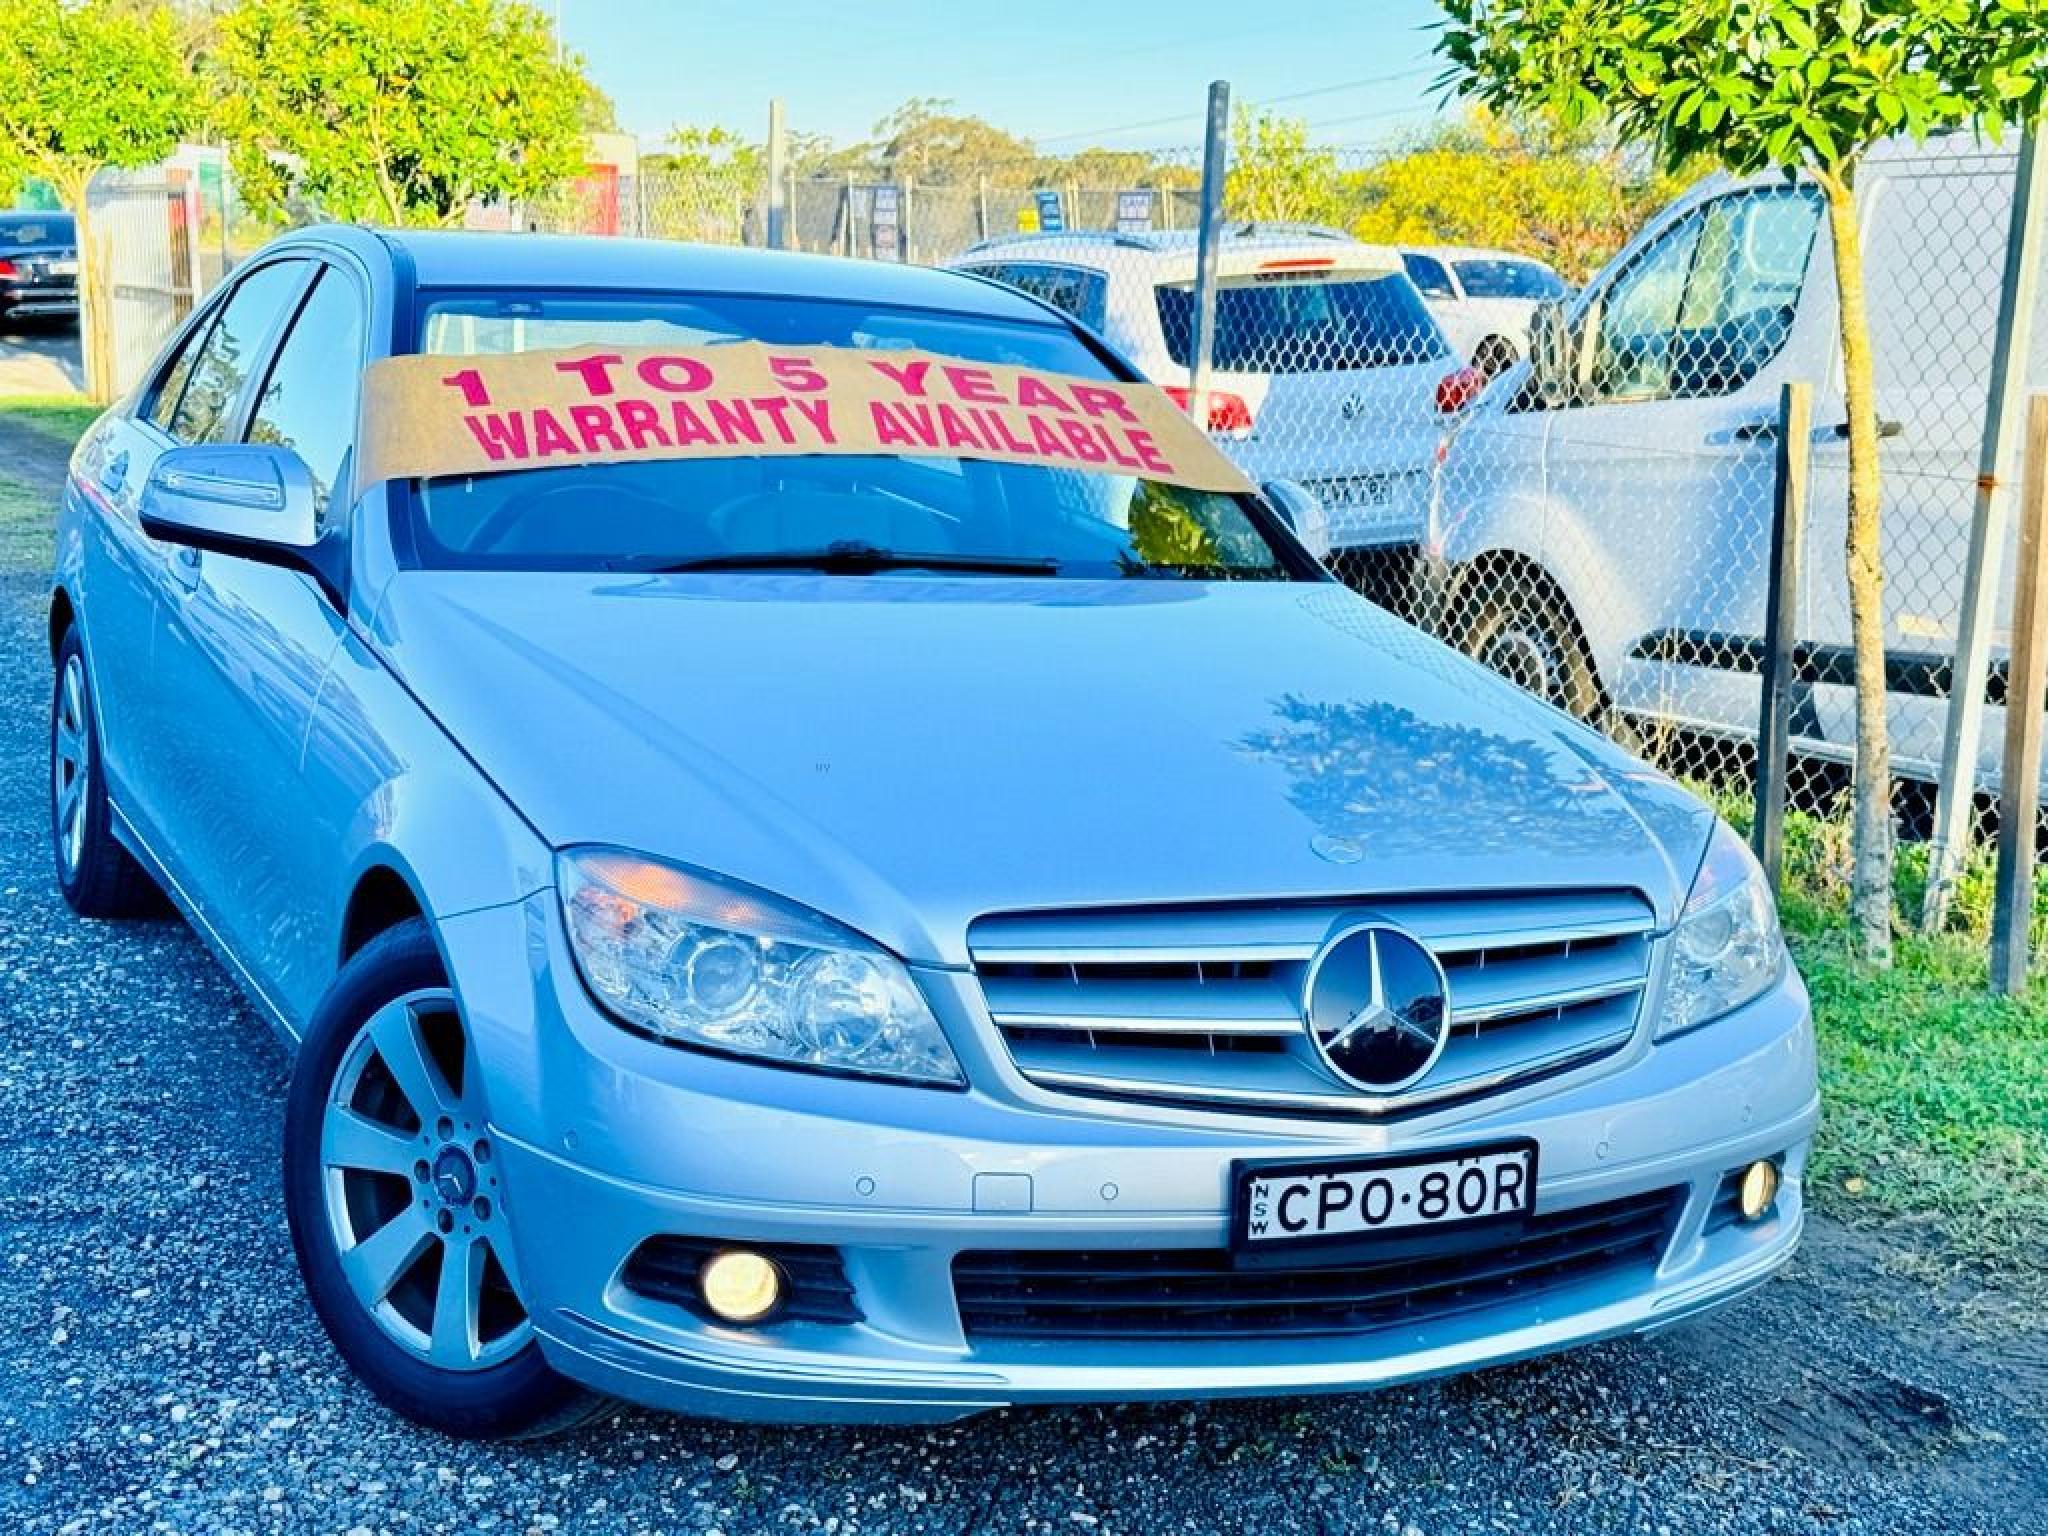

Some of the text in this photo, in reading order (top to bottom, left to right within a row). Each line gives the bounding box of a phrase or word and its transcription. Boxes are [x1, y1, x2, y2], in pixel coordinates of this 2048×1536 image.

[442, 354, 1140, 424] 1 TO 5 YEAR
[464, 396, 1174, 474] WARRANTY AVAILABLE
